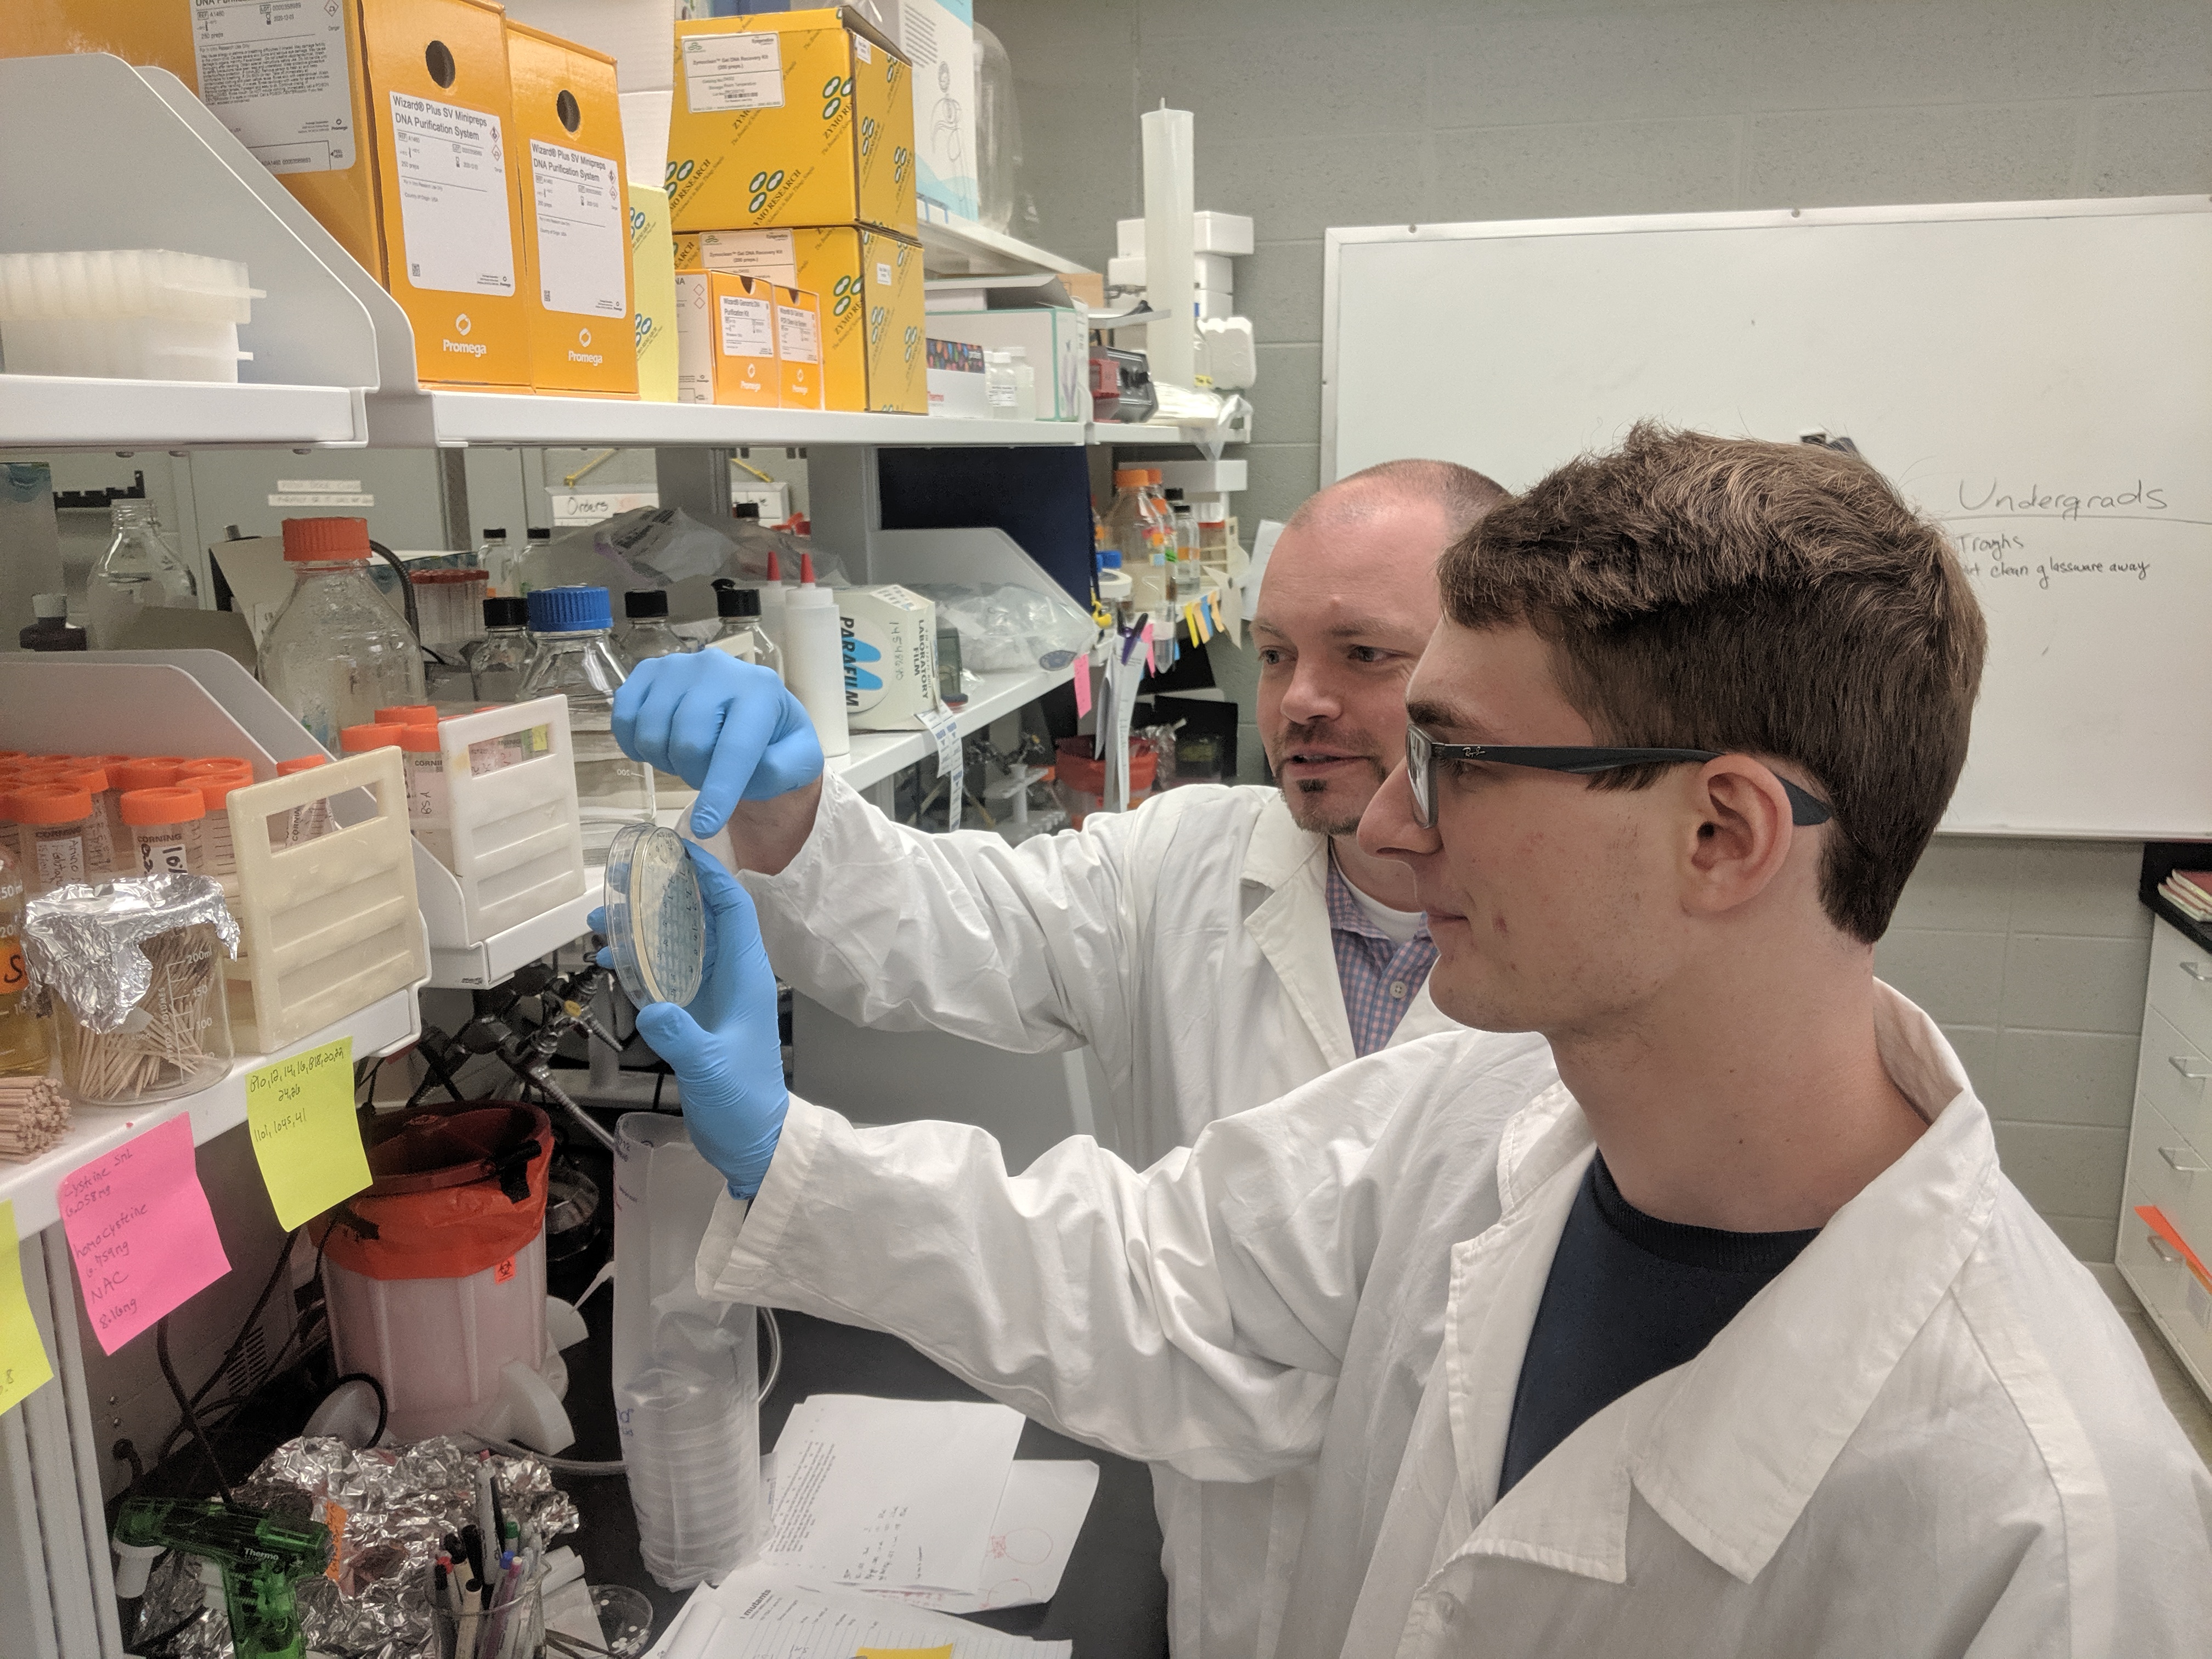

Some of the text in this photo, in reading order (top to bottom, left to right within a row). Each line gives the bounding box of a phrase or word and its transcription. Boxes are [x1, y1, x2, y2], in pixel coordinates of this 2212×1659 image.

[393, 95, 487, 127] Wizard® Plus SV Minipreps
[396, 113, 479, 140] DNA Purification System
[821, 113, 844, 139] ZYMO
[534, 158, 600, 182] DNA Purification System
[558, 150, 570, 161] Plus
[571, 154, 579, 163] SV
[580, 157, 606, 170] Minipreps
[676, 157, 713, 199] RESEARCH
[765, 168, 803, 210] RESEARCH
[832, 309, 854, 336] ZYMO
[443, 339, 487, 358] Promega
[640, 326, 658, 347] RESEARCH
[568, 350, 603, 366] Promega
[567, 496, 609, 516] Orders
[1959, 477, 2168, 521] Undergrads
[1990, 556, 2150, 590] clean glassware away
[840, 616, 859, 707] PARAFILM
[918, 619, 928, 699] LABORATORY
[420, 791, 432, 814] BSA
[137, 833, 182, 843] CORNING
[0, 885, 14, 900] 50
[187, 945, 213, 964] 200ml
[4, 954, 24, 983] S
[196, 1017, 213, 1030] 100
[91, 1271, 129, 1304] NAC
[245, 1547, 279, 1561] Thermo
[743, 1589, 771, 1616] mutants
